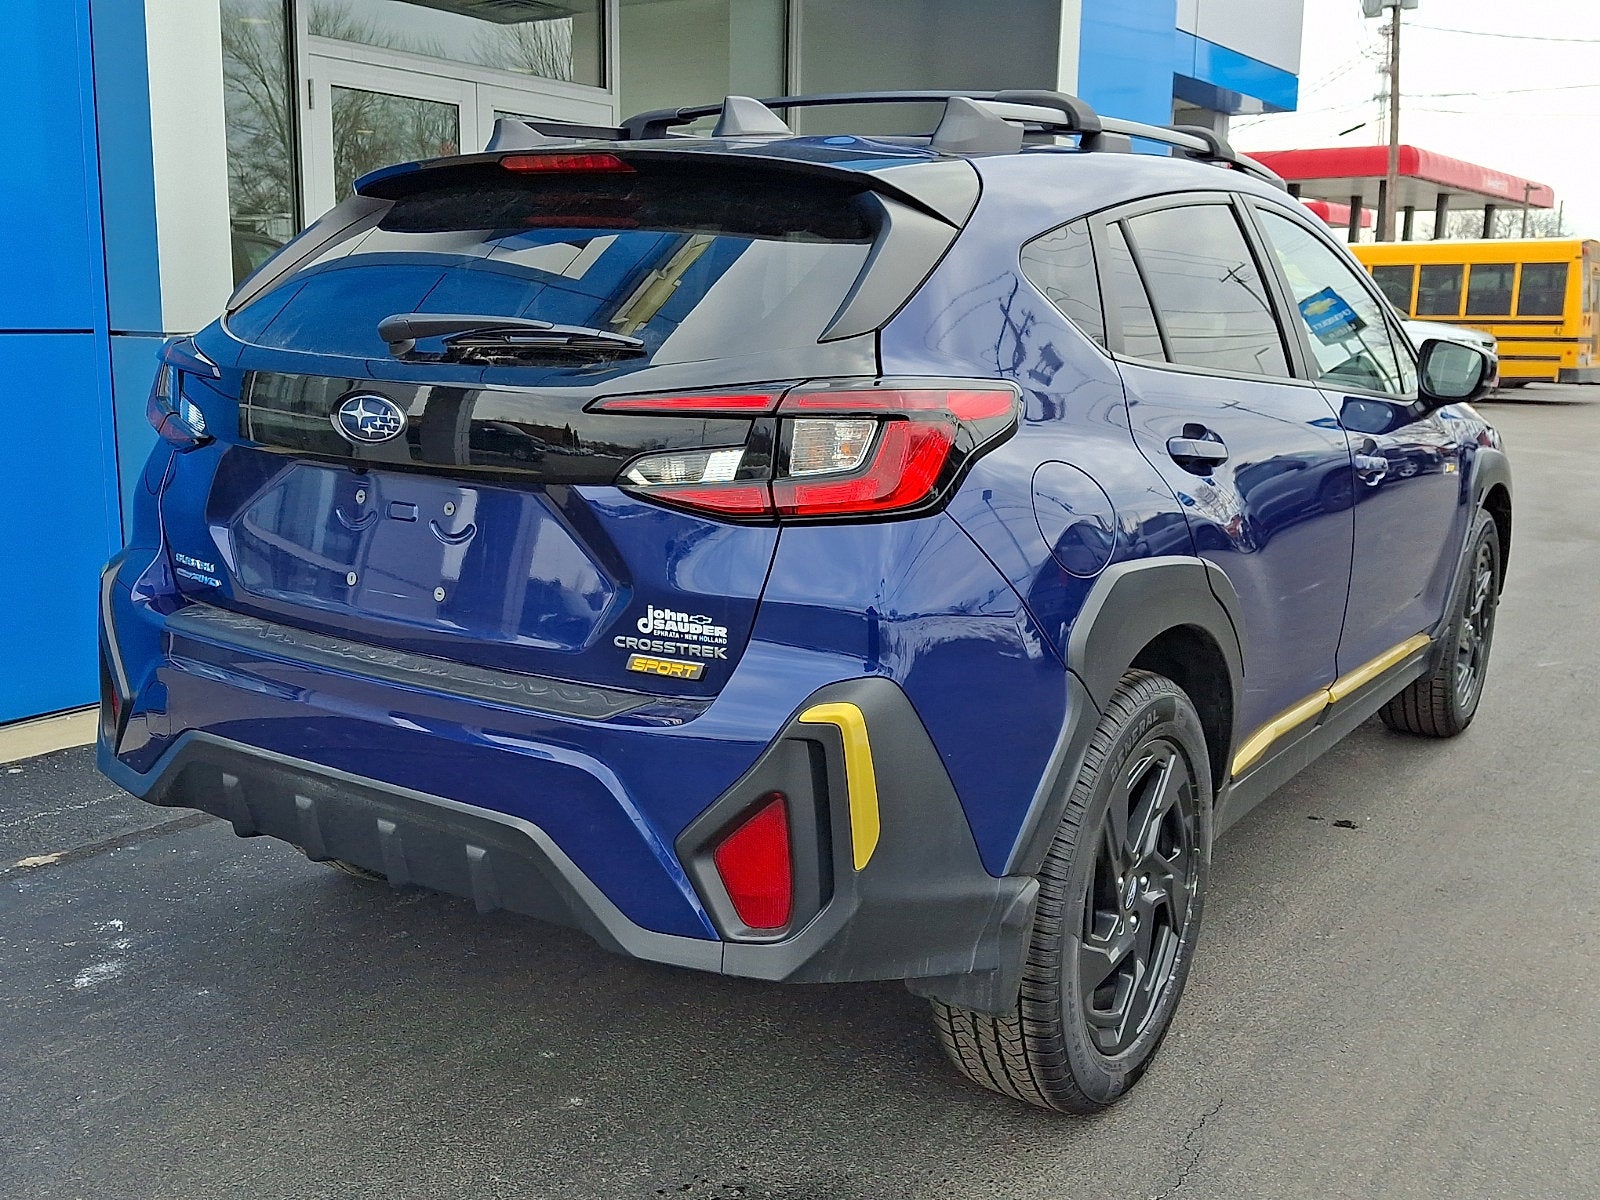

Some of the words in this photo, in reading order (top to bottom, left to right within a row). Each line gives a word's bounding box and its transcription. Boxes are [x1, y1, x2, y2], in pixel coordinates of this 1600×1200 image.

[637, 604, 689, 634] john
[653, 619, 728, 638] SAUDER
[653, 629, 680, 639] EPHRATA
[684, 633, 697, 641] NEW
[699, 635, 728, 645] HOLLAND
[613, 635, 728, 660] CROSSTREK
[631, 658, 698, 678] SPORT
